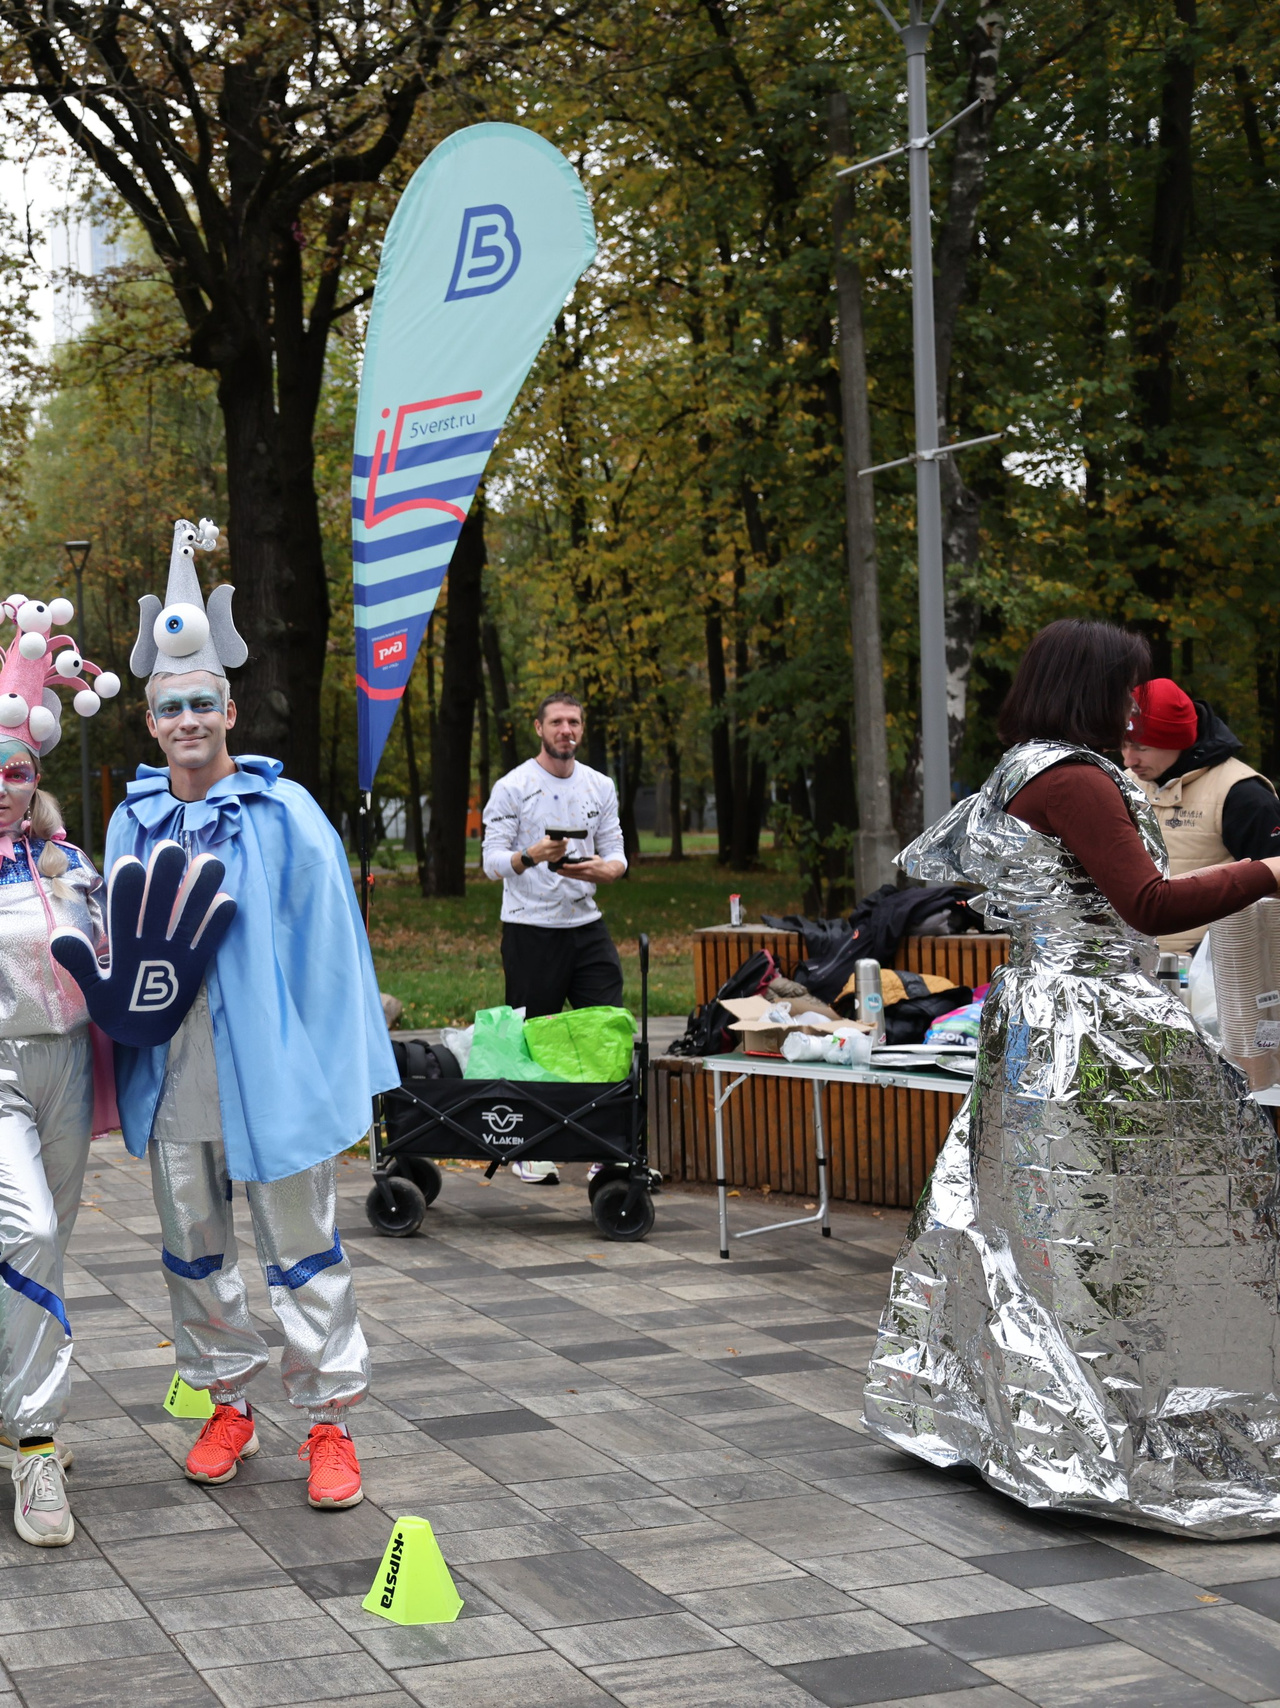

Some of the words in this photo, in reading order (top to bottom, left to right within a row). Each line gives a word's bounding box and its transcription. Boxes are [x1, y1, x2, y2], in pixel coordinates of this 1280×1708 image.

[410, 413, 476, 439] 5verst.ru
[482, 1133, 524, 1145] VLAKEN
[380, 1532, 404, 1609] KIPSTA
